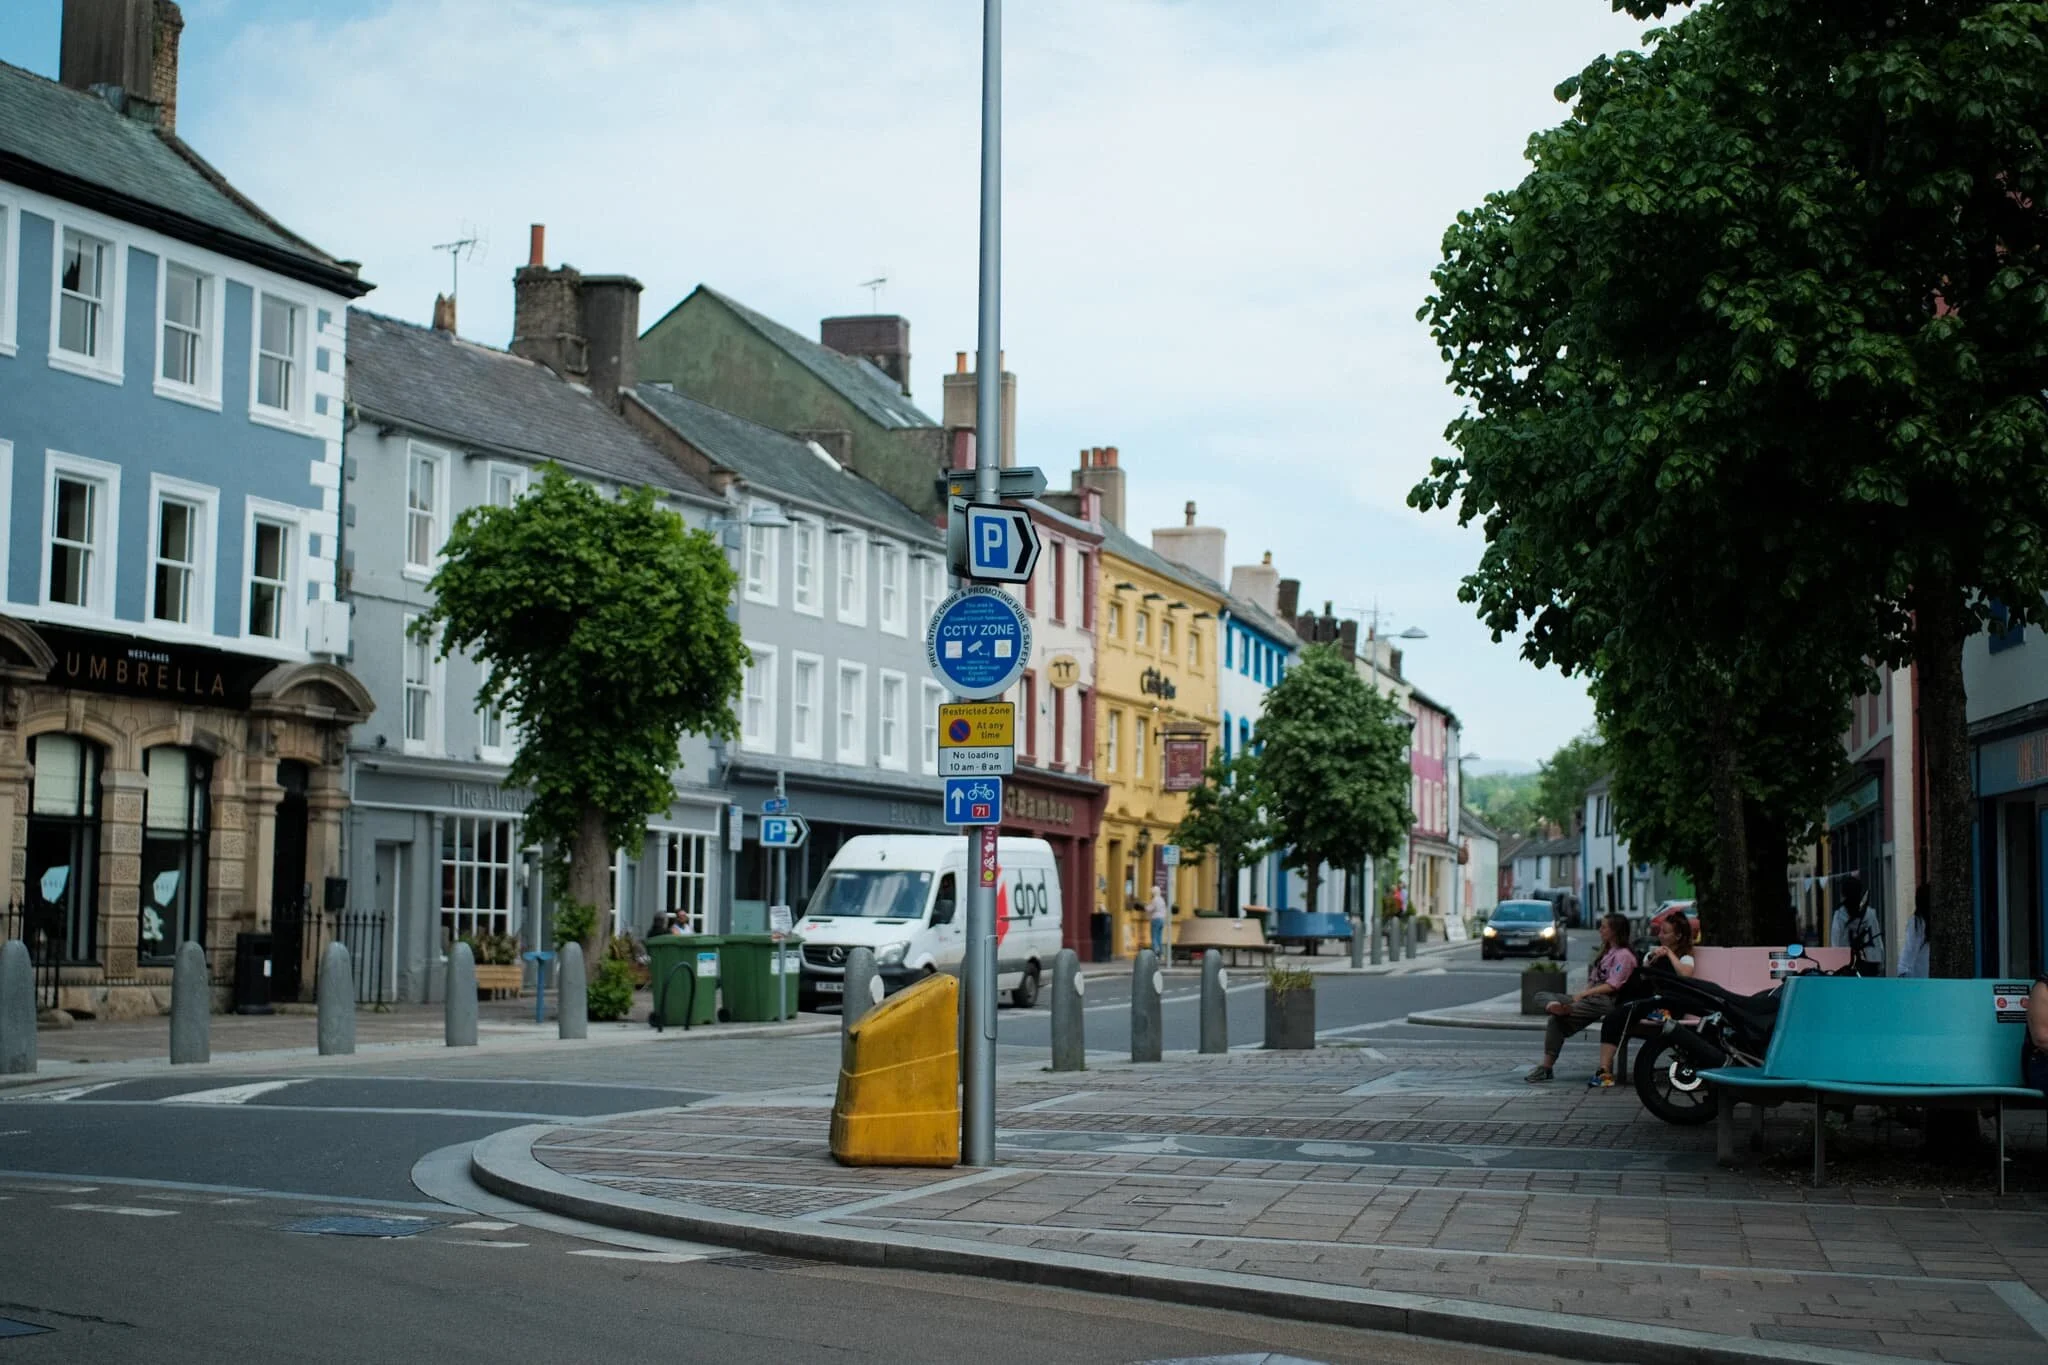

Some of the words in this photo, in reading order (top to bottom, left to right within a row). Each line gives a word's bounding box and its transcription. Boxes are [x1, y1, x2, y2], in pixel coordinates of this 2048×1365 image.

[983, 523, 1003, 563] P
[961, 590, 967, 598] &
[968, 587, 1014, 604] PROMOTING
[940, 595, 960, 615] CRIME
[1013, 604, 1029, 632] PUBLIC
[943, 625, 977, 637] CCTV
[980, 624, 1015, 636] ZONE
[928, 615, 940, 668] PREVENTING
[1019, 635, 1030, 668] SAFETY
[66, 652, 225, 697] UMBRELLA
[942, 707, 987, 717] Restricted
[989, 706, 1010, 715] Zone
[977, 722, 987, 730] At
[989, 722, 1004, 731] any
[981, 732, 1000, 740] time
[952, 752, 965, 760] No
[968, 751, 999, 761] loading
[950, 763, 960, 771] 10
[447, 782, 478, 809] The
[976, 806, 986, 816] 71
[769, 822, 783, 840] P
[1014, 868, 1048, 927] dpd
